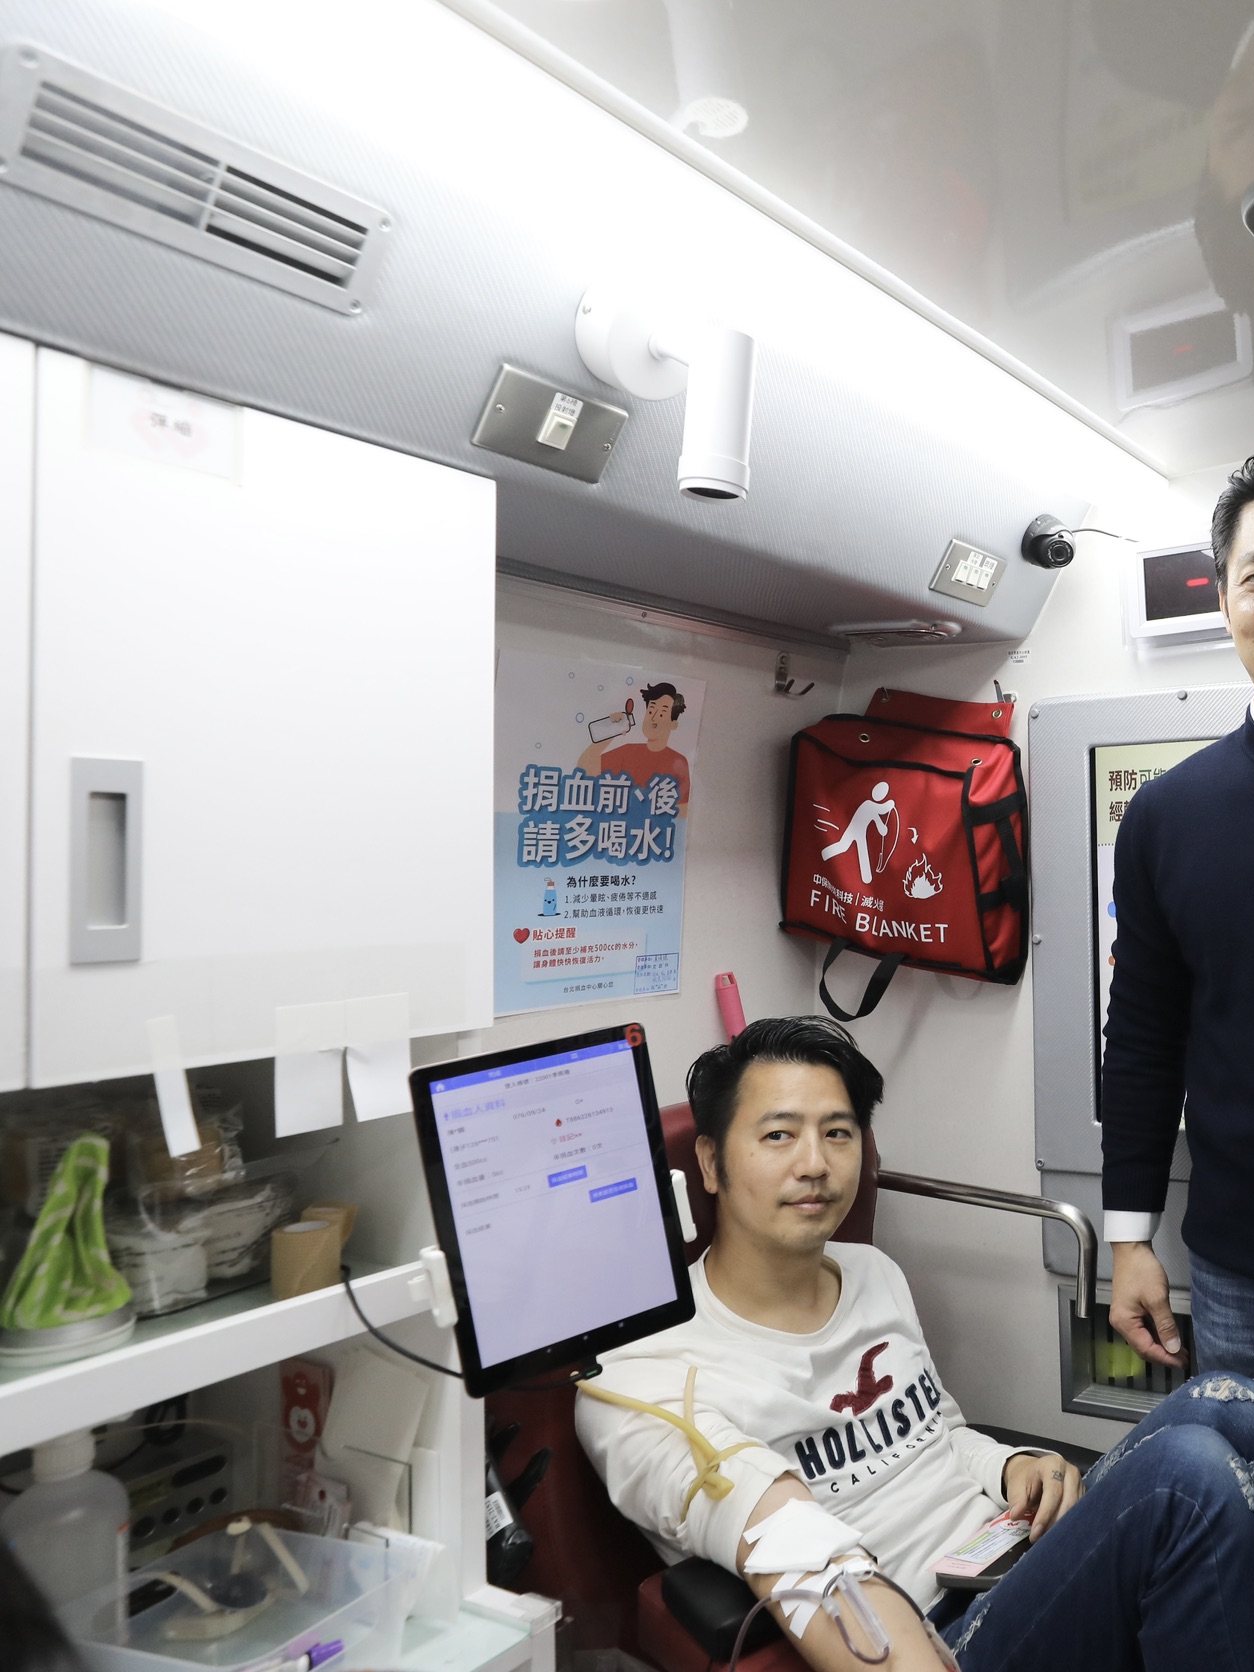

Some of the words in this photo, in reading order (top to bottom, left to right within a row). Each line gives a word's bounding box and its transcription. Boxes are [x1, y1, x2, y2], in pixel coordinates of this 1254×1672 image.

[522, 768, 679, 816] 捐血前、後
[1109, 800, 1130, 822] 經
[522, 815, 672, 863] 請多喝水!
[566, 875, 636, 889] 為什麼要喝水?
[810, 889, 847, 924] FIRE
[855, 912, 949, 943] BLANKET
[532, 927, 577, 941] 貼心提醒
[625, 1024, 643, 1047] 6
